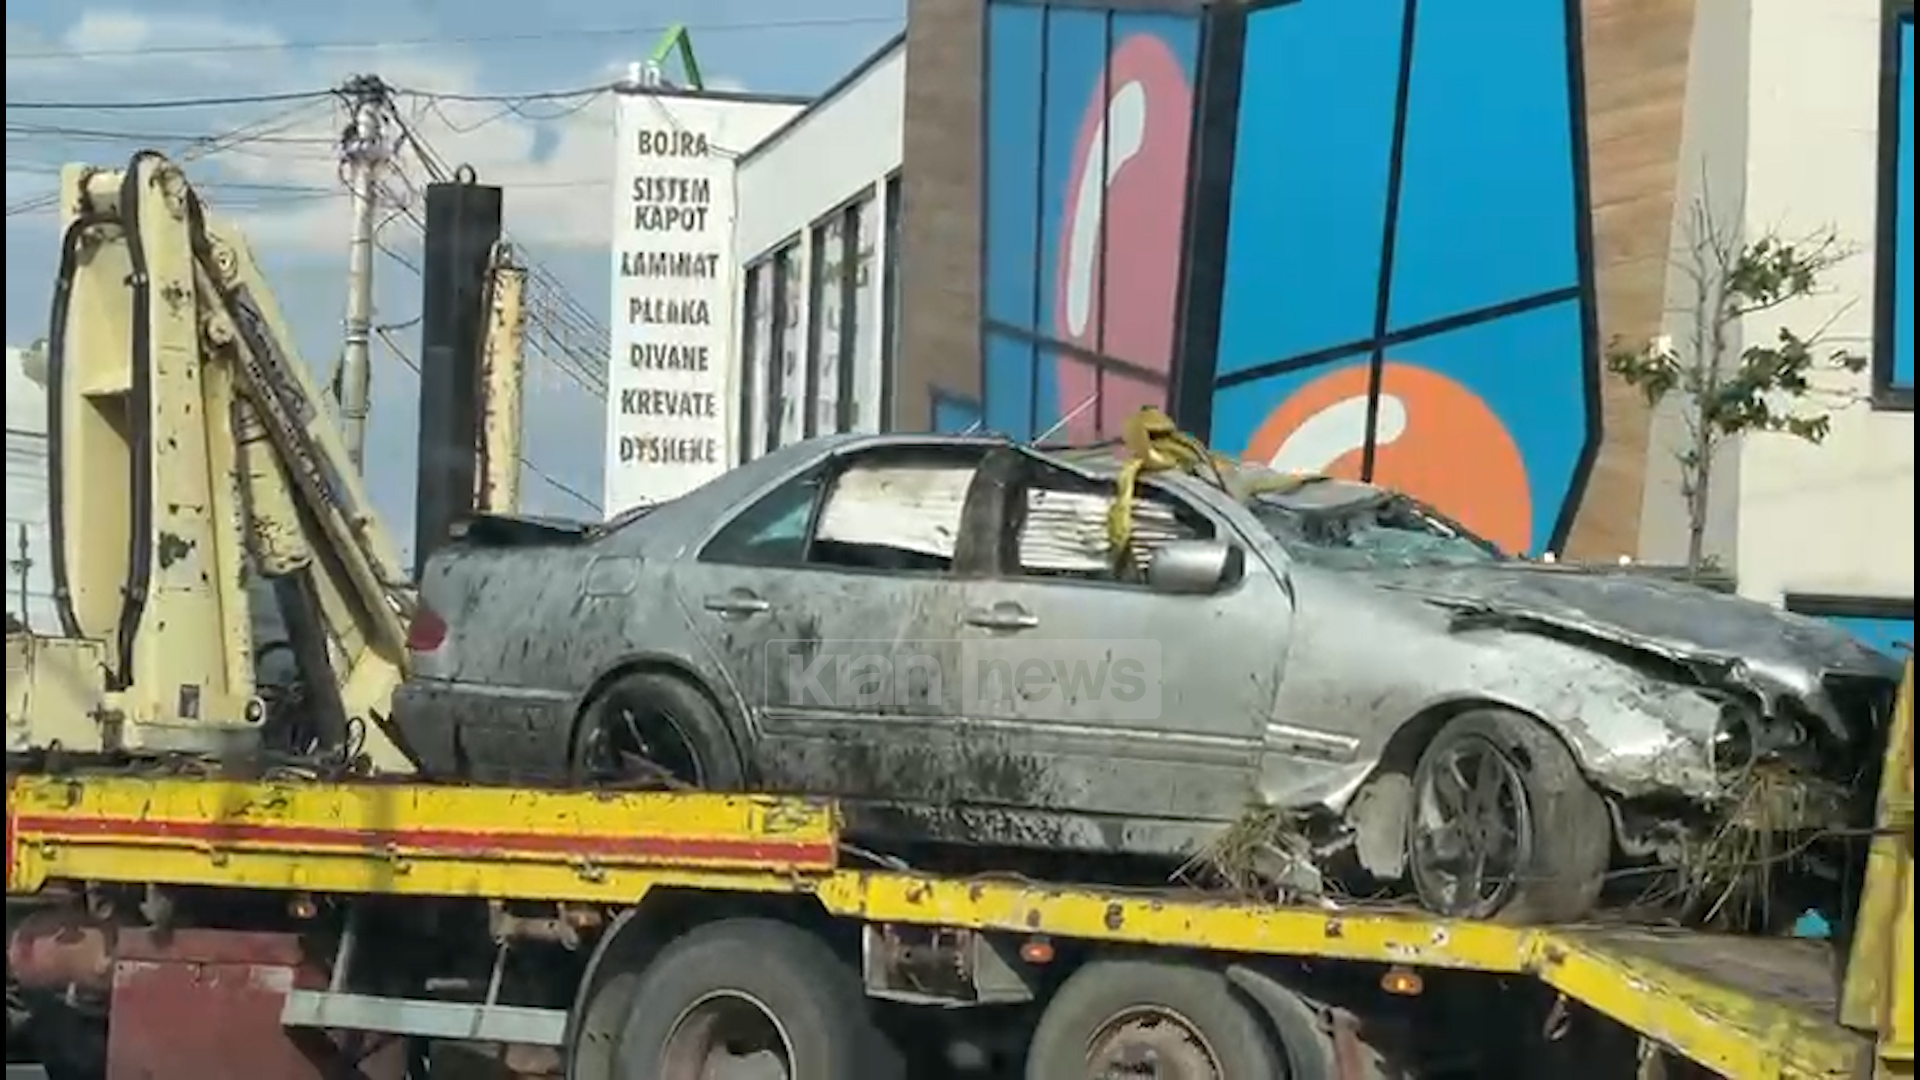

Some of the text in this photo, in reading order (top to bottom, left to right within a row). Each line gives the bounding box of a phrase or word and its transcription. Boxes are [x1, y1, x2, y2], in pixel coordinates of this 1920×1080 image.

[638, 130, 710, 157] BOJRA
[633, 177, 710, 203] SISTEM
[635, 206, 708, 231] KAPOT
[630, 343, 708, 371] DIVANE
[621, 389, 716, 418] KREVATE
